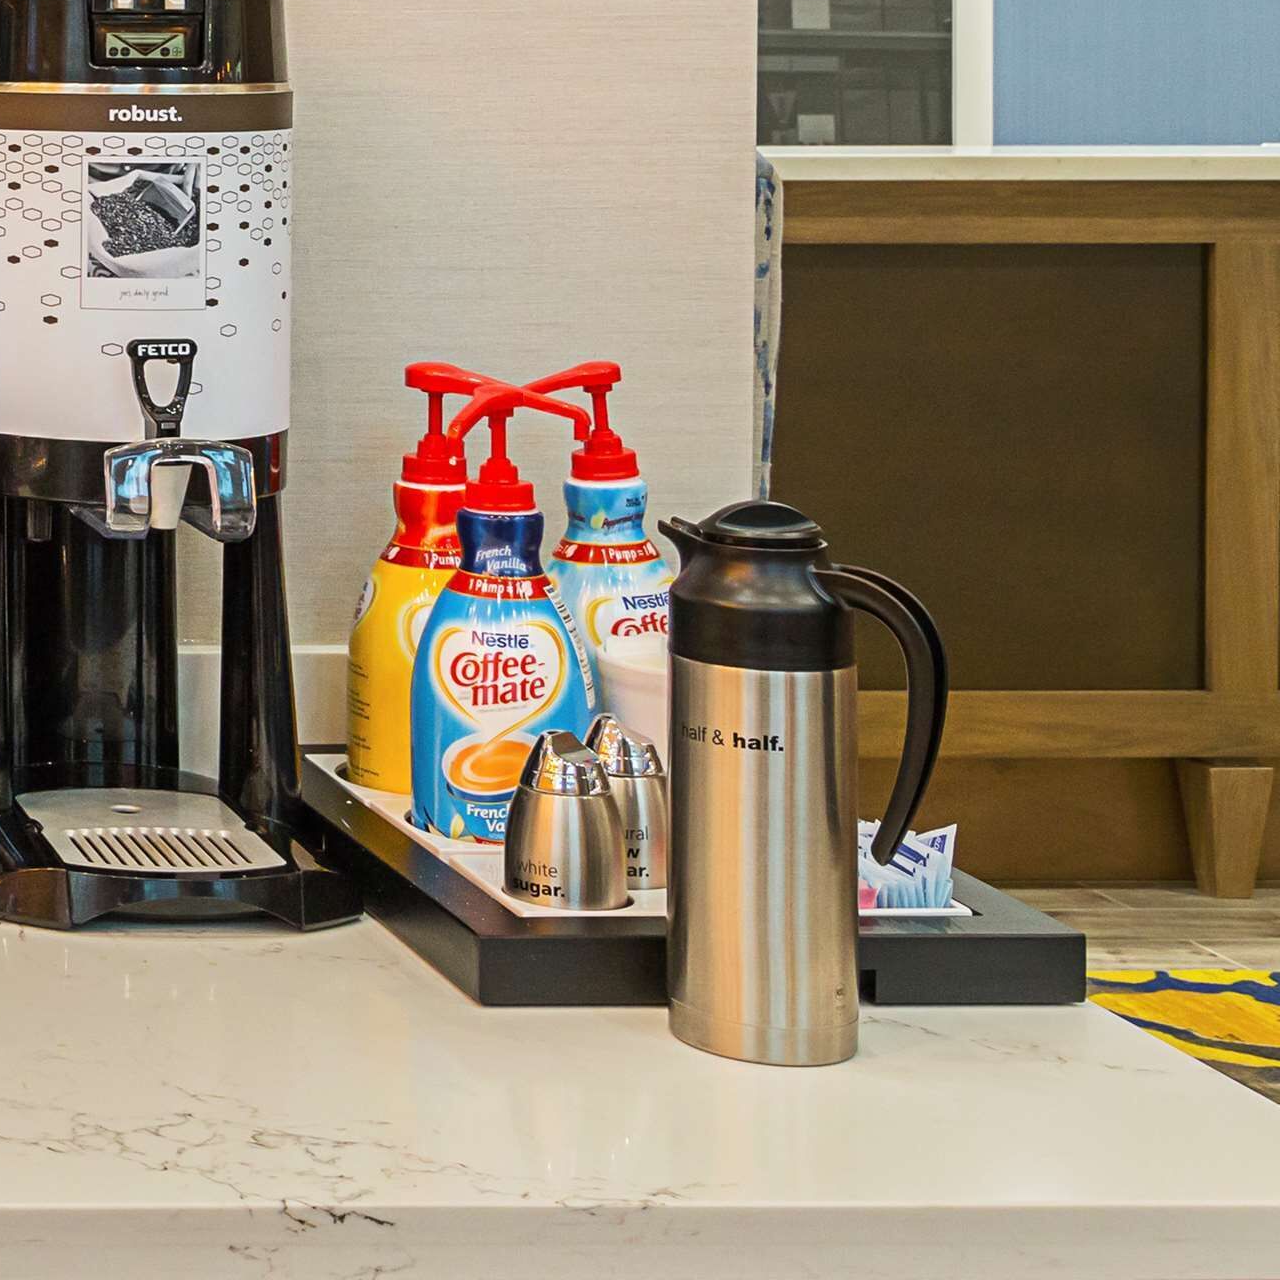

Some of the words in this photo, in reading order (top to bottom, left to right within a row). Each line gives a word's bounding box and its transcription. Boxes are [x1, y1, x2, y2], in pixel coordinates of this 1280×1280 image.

[109, 105, 182, 122] robust.
[137, 343, 191, 356] FETCO
[476, 545, 512, 561] French
[486, 558, 528, 572] Vanilla
[471, 676, 545, 706] mate
[682, 725, 707, 742] half
[712, 729, 724, 746] &
[733, 732, 784, 751] half.
[519, 859, 558, 879] white
[513, 876, 565, 897] sugar.
